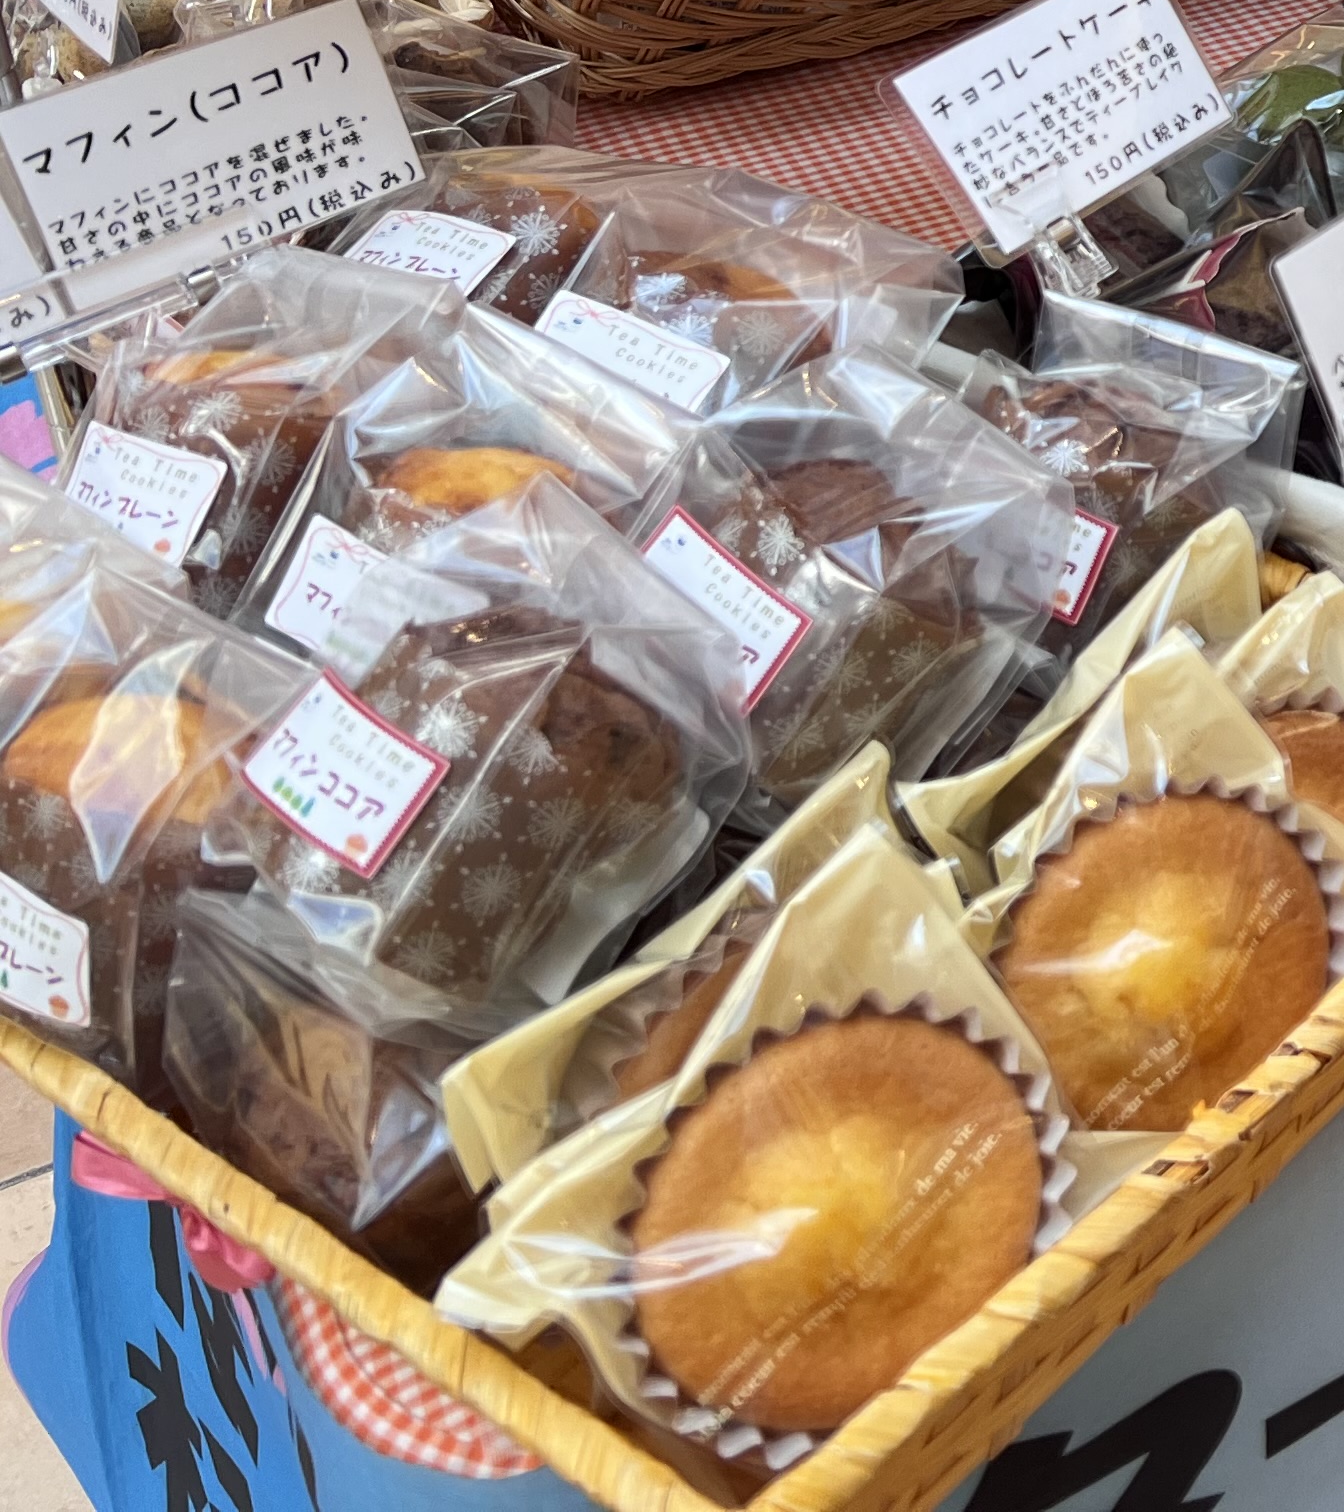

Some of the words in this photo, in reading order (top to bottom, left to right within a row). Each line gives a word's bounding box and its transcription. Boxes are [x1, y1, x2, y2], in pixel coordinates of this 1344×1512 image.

[22, 40, 351, 176] マフィン(ココア)
[953, 32, 1164, 157] チョコレートをふんだんに使っ
[963, 41, 1180, 175] たケーキ。甘さとほろ苦さの絶
[972, 60, 1184, 192] 妙なバランスでティーブレイク
[1085, 92, 1222, 186] 150円(税込み)
[47, 114, 371, 236] マフィンにココアを混ぜました。
[59, 130, 364, 255] 甘さの中にココアの風味が味
[220, 160, 418, 253] 150円(税込み)
[607, 324, 641, 347] Tea
[653, 343, 700, 371] Time
[614, 347, 690, 384] Cookies
[703, 552, 732, 585] Tea
[741, 584, 785, 627] Time
[703, 581, 772, 641] Cookies
